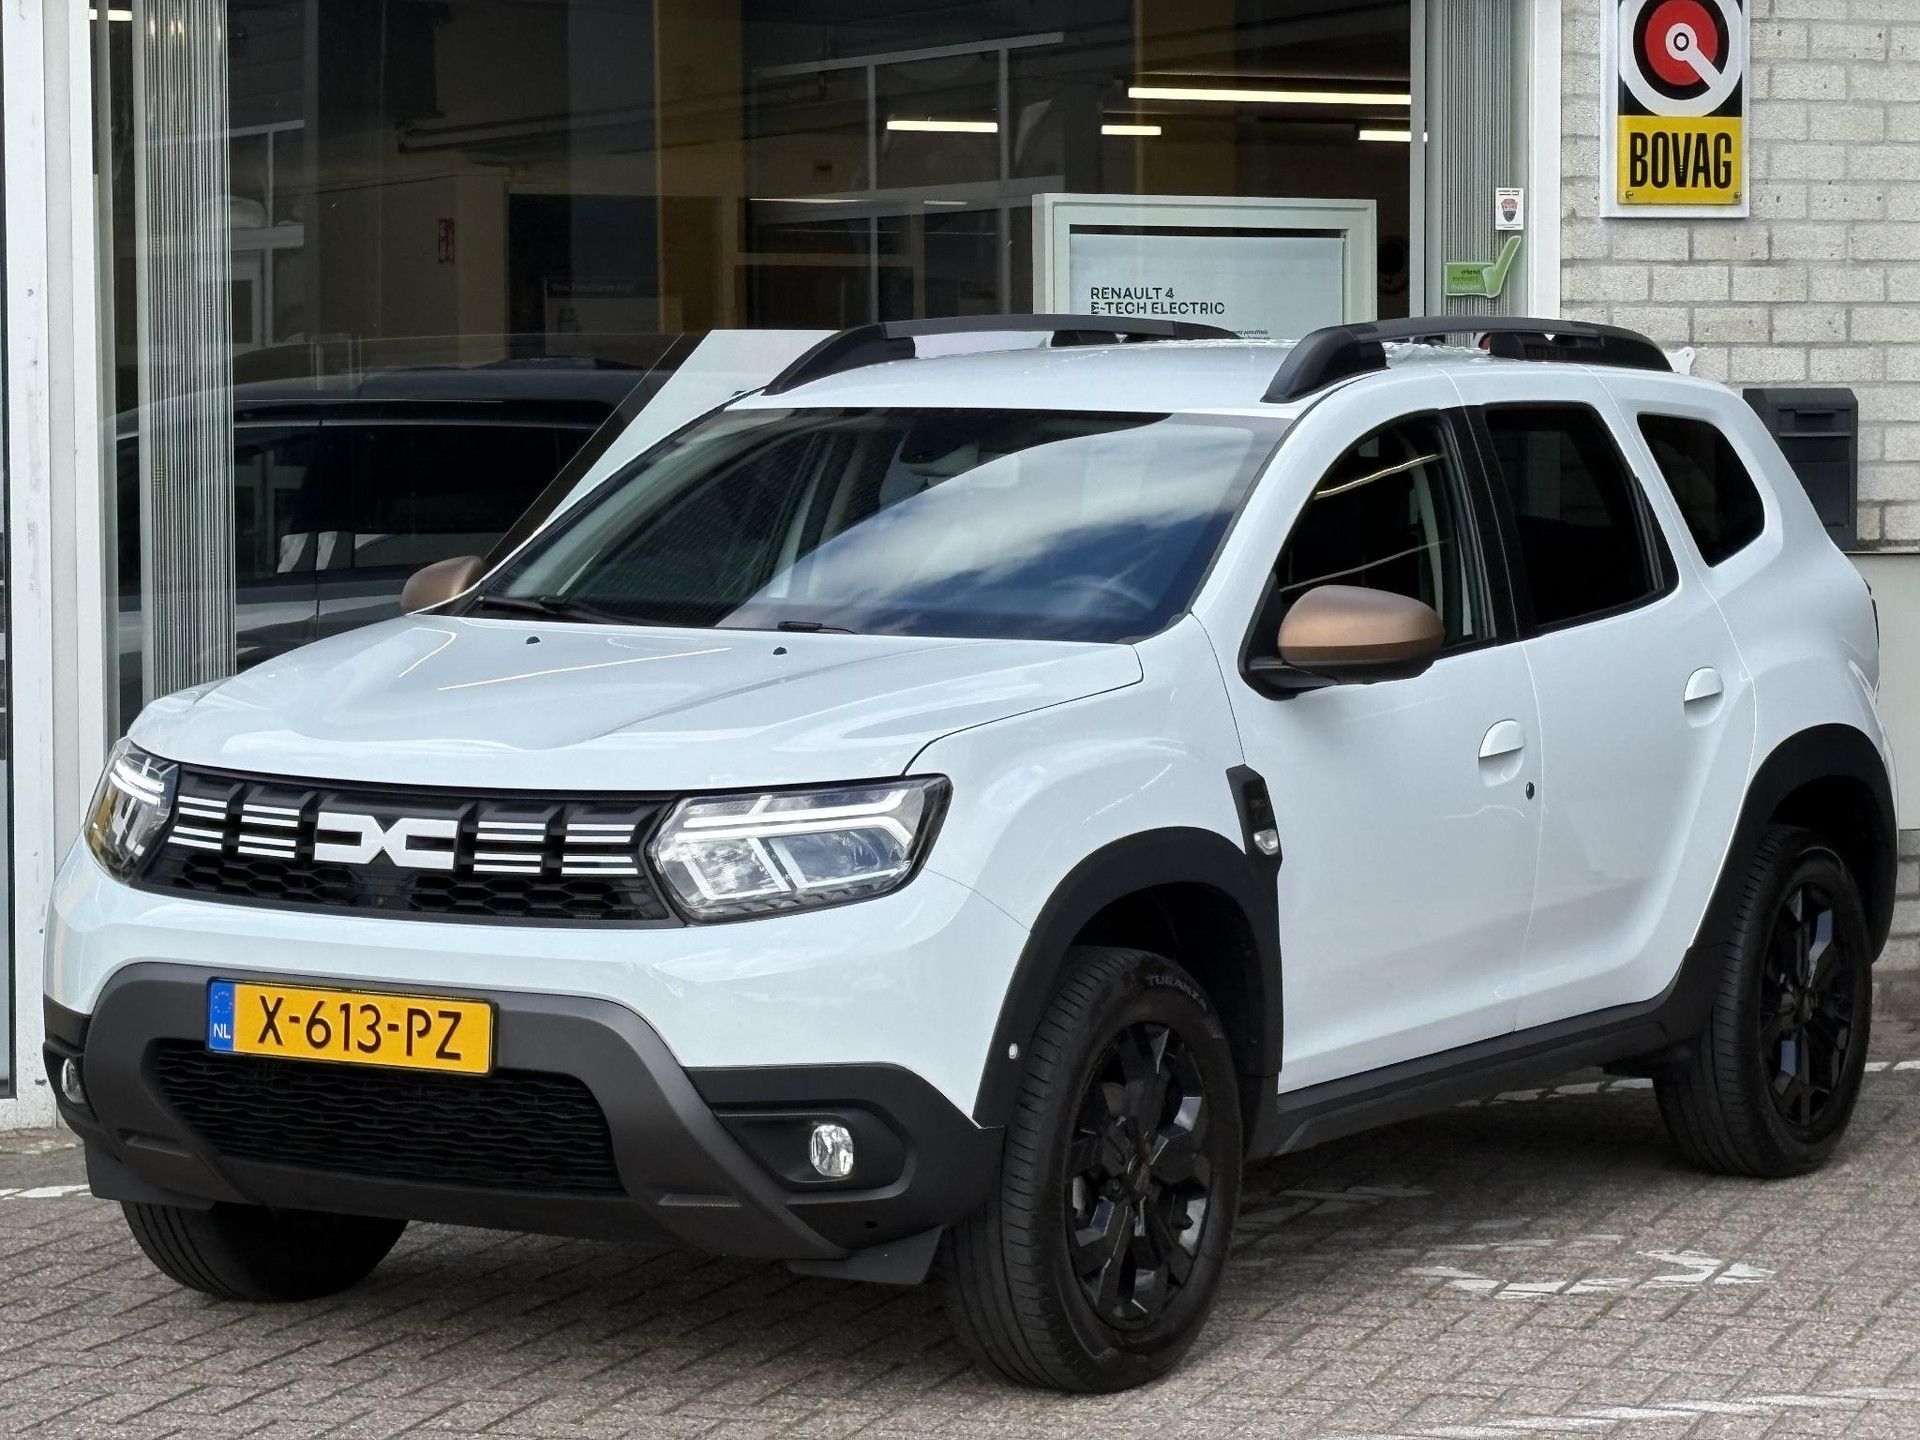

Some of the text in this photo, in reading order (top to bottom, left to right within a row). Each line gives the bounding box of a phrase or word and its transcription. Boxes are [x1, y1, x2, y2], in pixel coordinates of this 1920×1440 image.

[1629, 131, 1732, 189] BOVAG
[1090, 287, 1175, 300] RENAULT 4
[1090, 301, 1226, 315] E-TECH ELECTRIC
[213, 1023, 231, 1040] NL
[257, 995, 462, 1061] X-613-PZ
